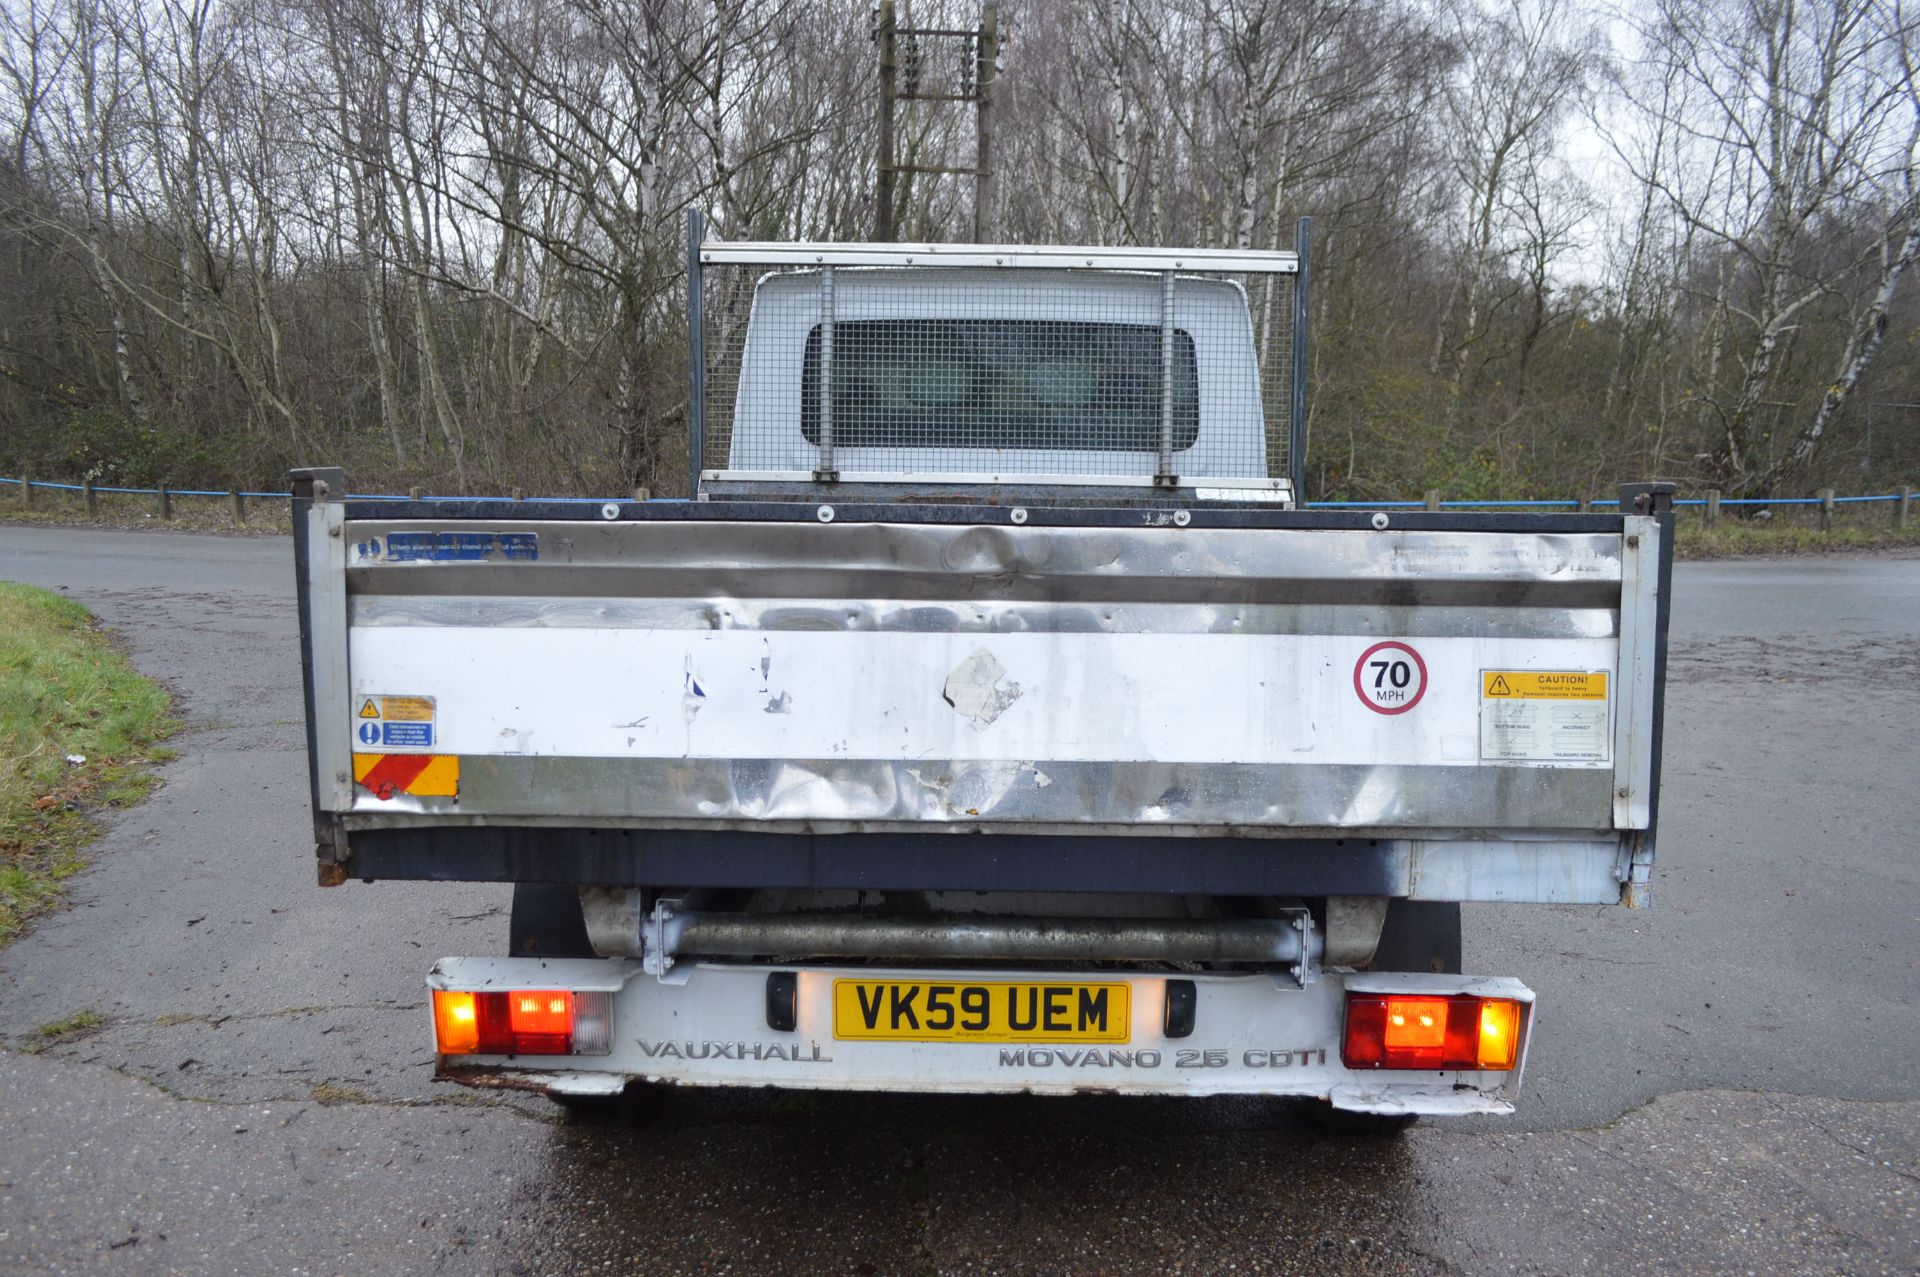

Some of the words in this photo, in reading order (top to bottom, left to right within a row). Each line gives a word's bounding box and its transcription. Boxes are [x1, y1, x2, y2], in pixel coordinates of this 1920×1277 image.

[1370, 660, 1411, 689] 70
[1538, 675, 1589, 685] CAUTION!
[1376, 690, 1405, 702] MPH
[856, 984, 991, 1031] VK59
[1008, 986, 1109, 1032] UEM
[635, 1038, 833, 1063] VAUXHALL
[998, 1048, 1162, 1070] MOVANO
[1243, 1049, 1327, 1068] CDTI
